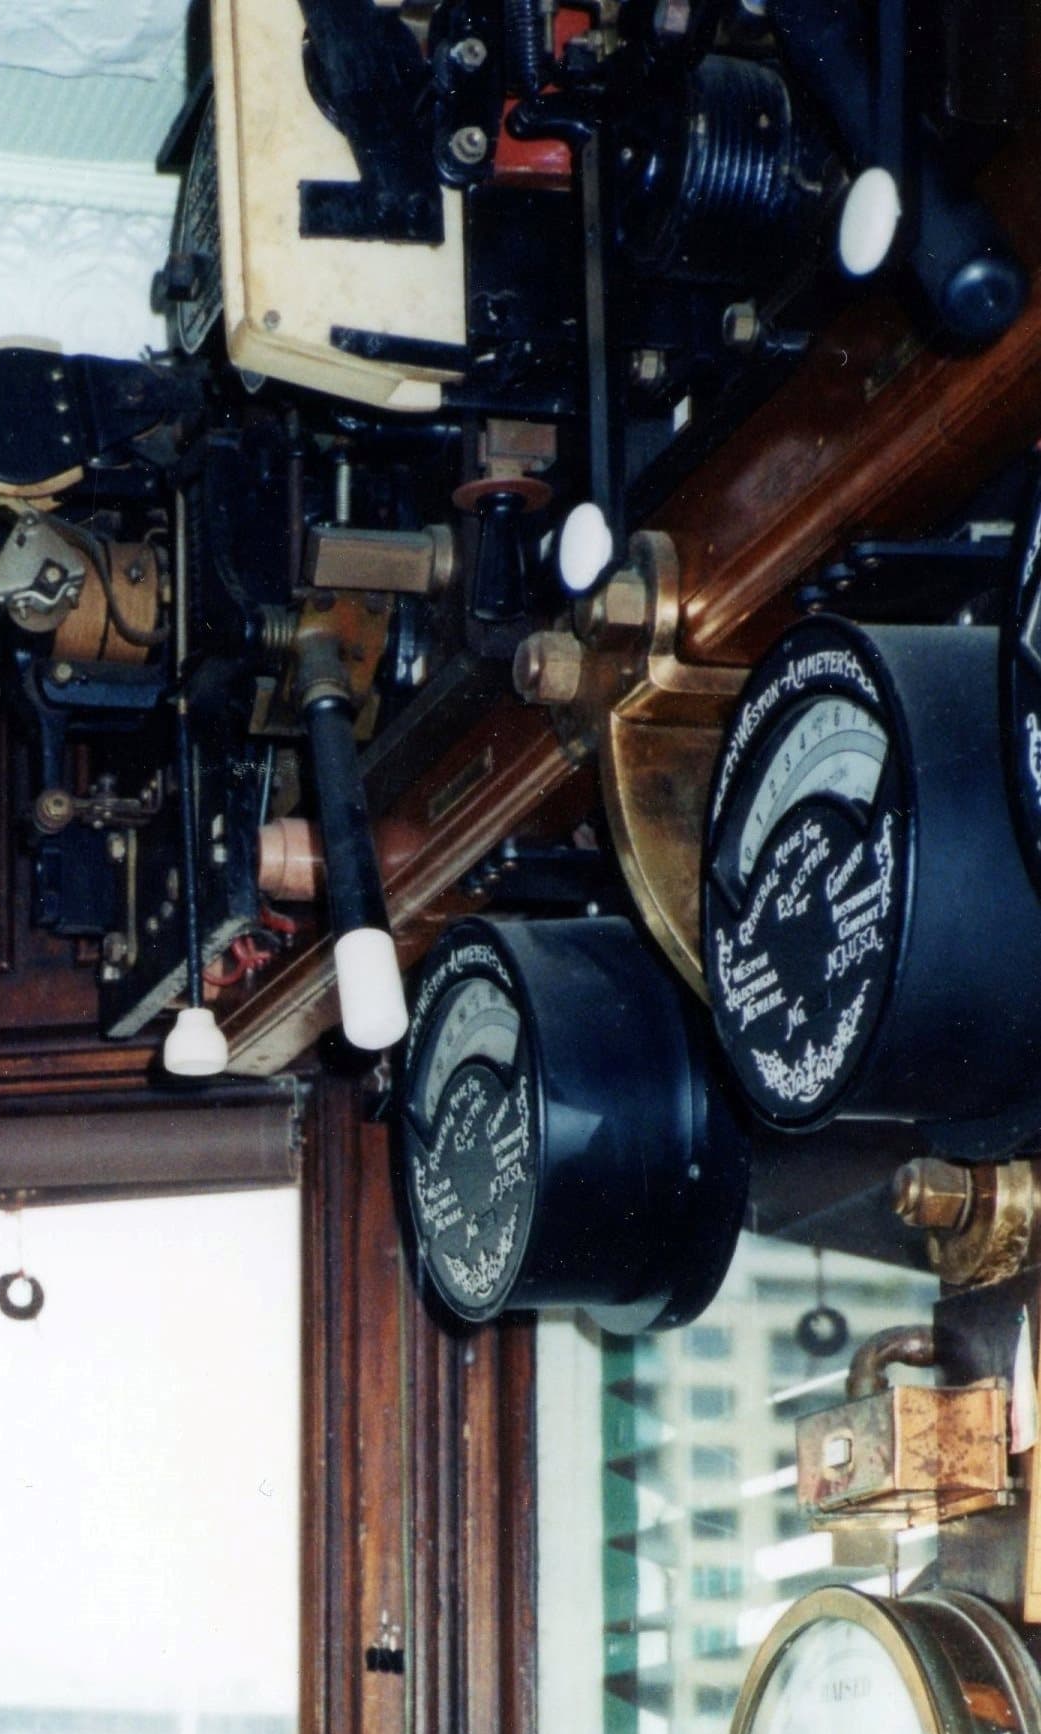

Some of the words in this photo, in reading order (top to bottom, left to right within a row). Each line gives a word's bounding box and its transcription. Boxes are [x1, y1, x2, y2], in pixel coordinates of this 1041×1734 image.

[735, 679, 780, 748] WESTON
[739, 869, 779, 946] GENERAL
[777, 838, 830, 920] ELECTRIC
[826, 841, 863, 901] COMPANY
[839, 903, 880, 940] COMPANY
[732, 951, 769, 983] WESTON
